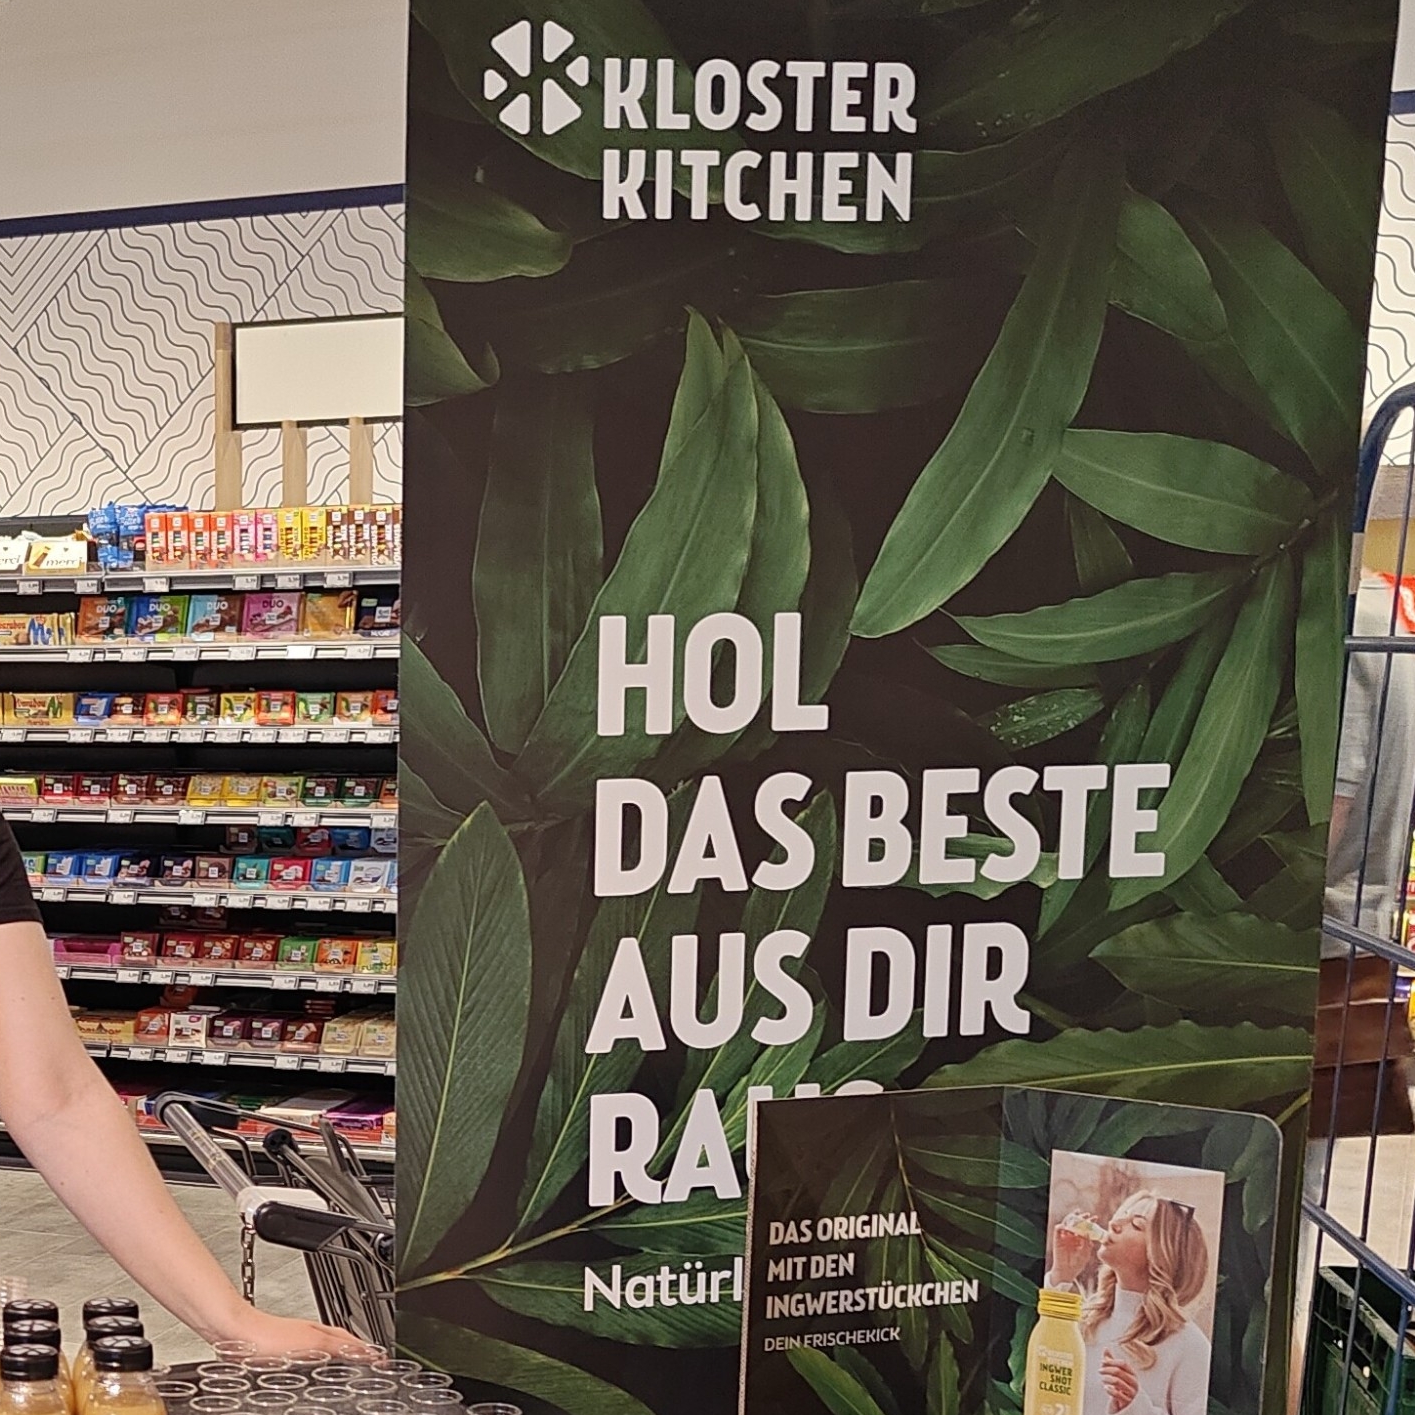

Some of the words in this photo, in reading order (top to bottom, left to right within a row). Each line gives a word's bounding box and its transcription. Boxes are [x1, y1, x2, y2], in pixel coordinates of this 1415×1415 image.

[602, 57, 918, 135] KLOSTER
[602, 149, 913, 222] KITCHEN
[96, 604, 117, 614] DUO
[149, 602, 171, 613] DUO
[206, 601, 229, 611] DUO
[262, 600, 284, 609] DUO
[598, 611, 830, 737] HOL
[594, 772, 816, 898] DAS
[842, 763, 1172, 889] BESTE
[584, 929, 815, 1055] AUS
[843, 921, 1032, 1044] DIR
[768, 1218, 814, 1247] DAS
[815, 1211, 924, 1243] ORIGINAL
[766, 1258, 805, 1283] MIT
[808, 1252, 857, 1281] DEN
[765, 1279, 981, 1320] INGWERSTÜCKCHEN
[764, 1332, 802, 1353] DEIN
[803, 1325, 903, 1350] FRISCHEKICK
[1039, 1362, 1073, 1377] INGWER
[1050, 1374, 1072, 1386] SHOT
[1039, 1381, 1072, 1396] CLASSIC
